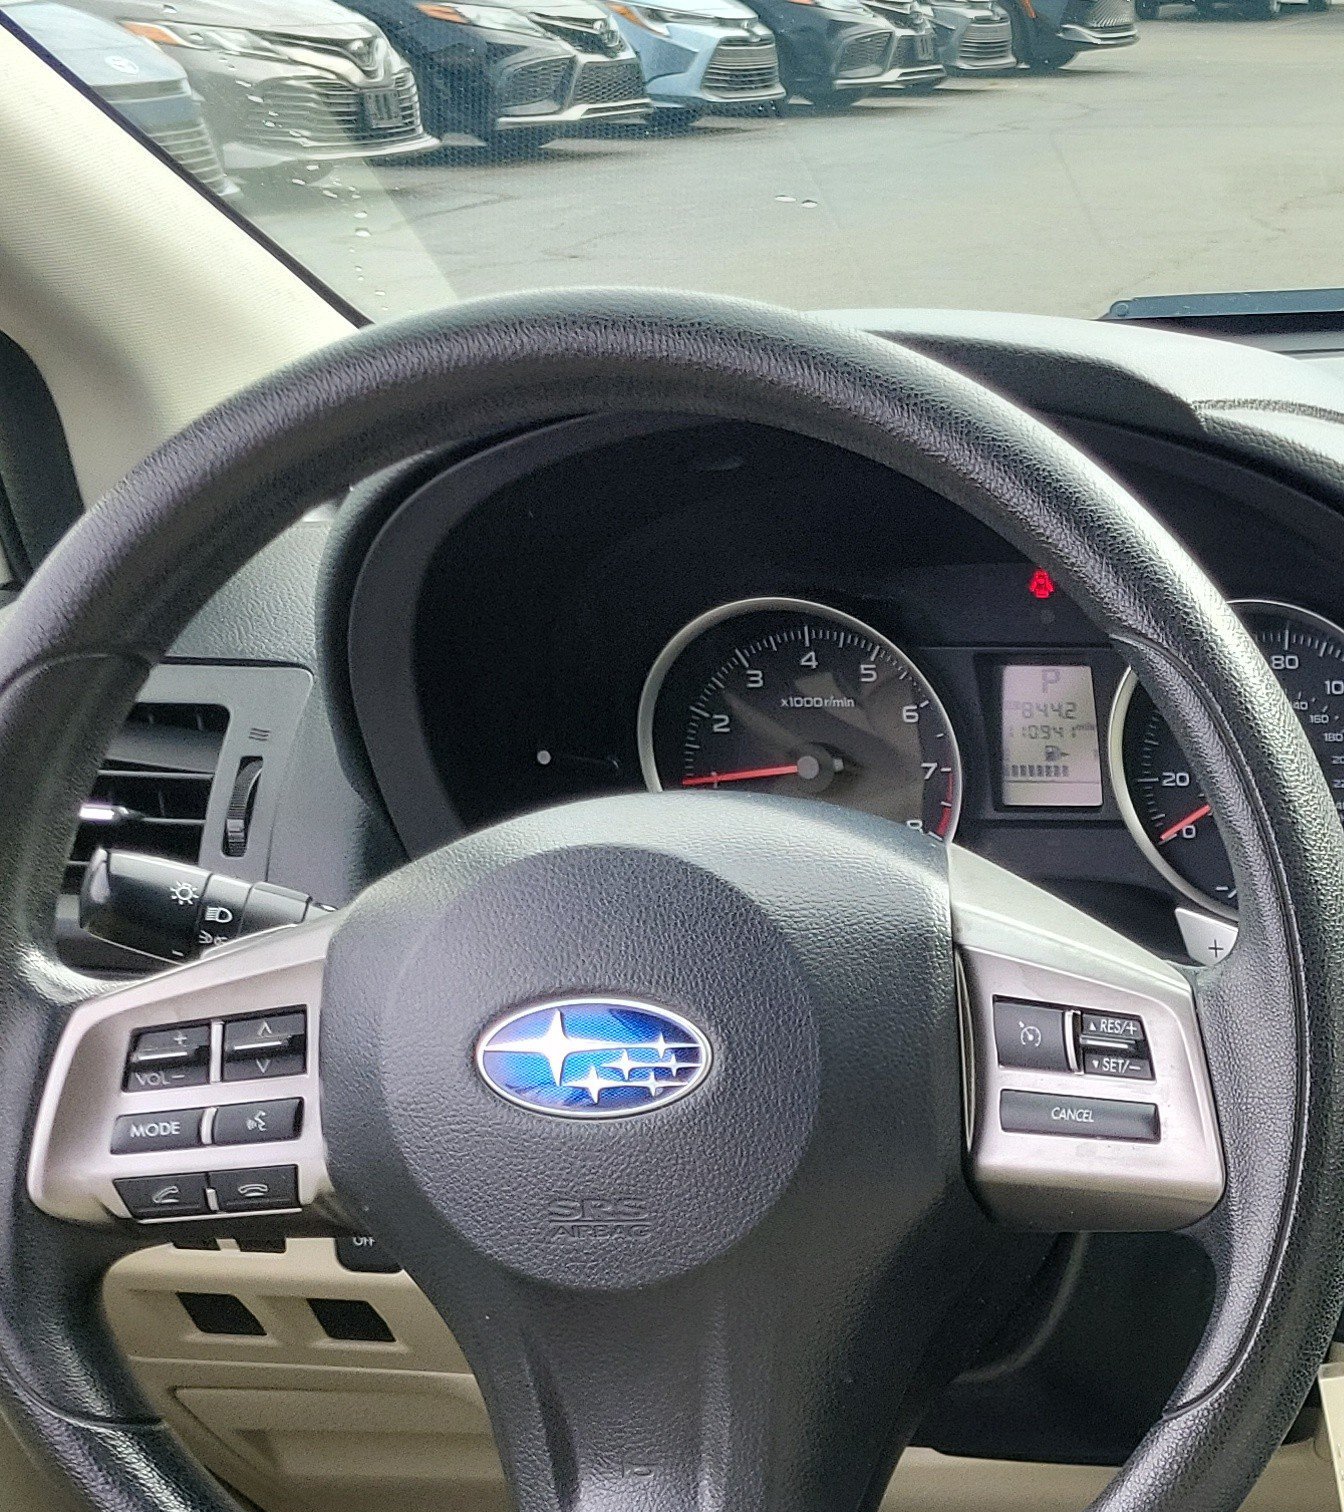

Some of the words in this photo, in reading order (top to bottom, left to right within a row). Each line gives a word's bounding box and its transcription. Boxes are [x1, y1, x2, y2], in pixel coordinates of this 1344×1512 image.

[800, 652, 818, 668] 4
[1271, 655, 1299, 670] 80
[747, 670, 763, 688] 3
[861, 664, 877, 682] 5
[1042, 668, 1061, 693] P
[903, 705, 919, 723] 6
[1309, 713, 1330, 724] 160
[713, 715, 730, 733] 2
[1323, 732, 1344, 743] 180
[921, 763, 938, 780] 7
[1162, 772, 1190, 787] 20
[1182, 826, 1196, 839] 0
[1051, 1106, 1094, 1122] CANCEL
[130, 1121, 182, 1138] MODE
